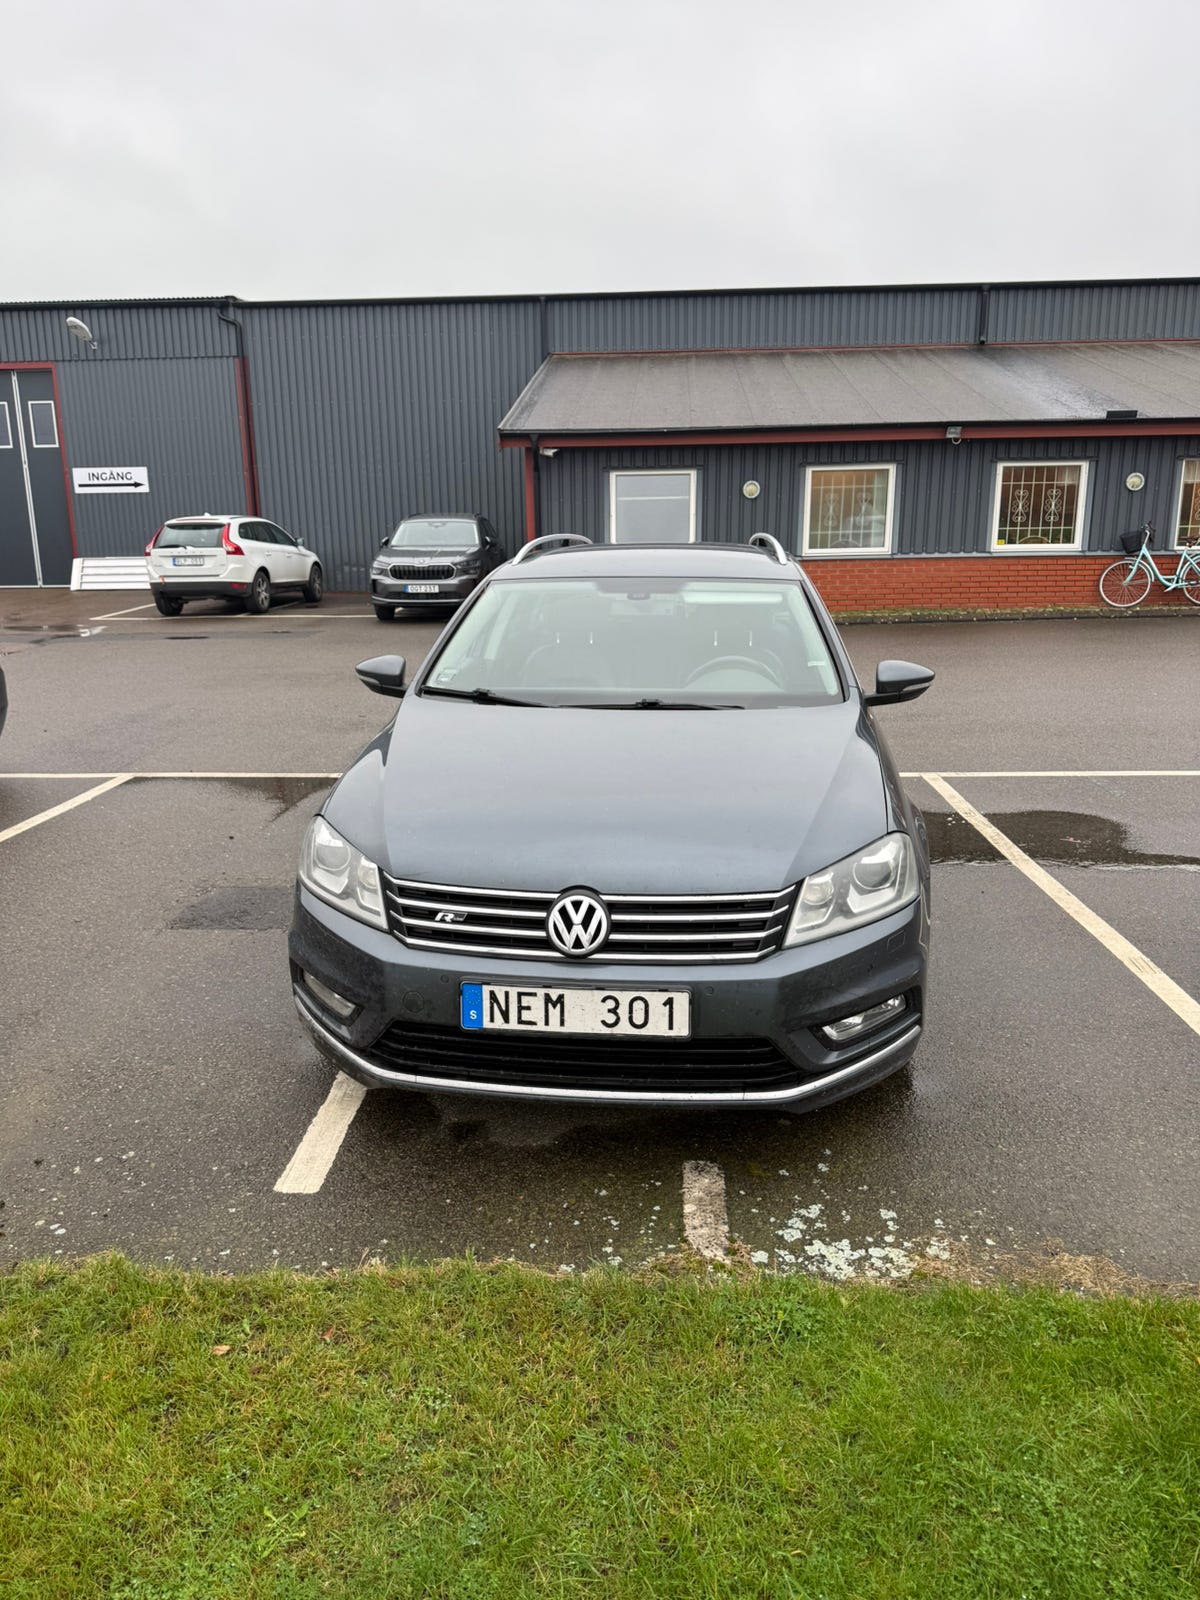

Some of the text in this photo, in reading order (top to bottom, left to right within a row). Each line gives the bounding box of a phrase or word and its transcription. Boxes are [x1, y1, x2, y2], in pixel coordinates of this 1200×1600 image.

[88, 470, 133, 481] INGÅNG
[469, 1010, 478, 1020] S
[489, 989, 675, 1031] NEM 301
